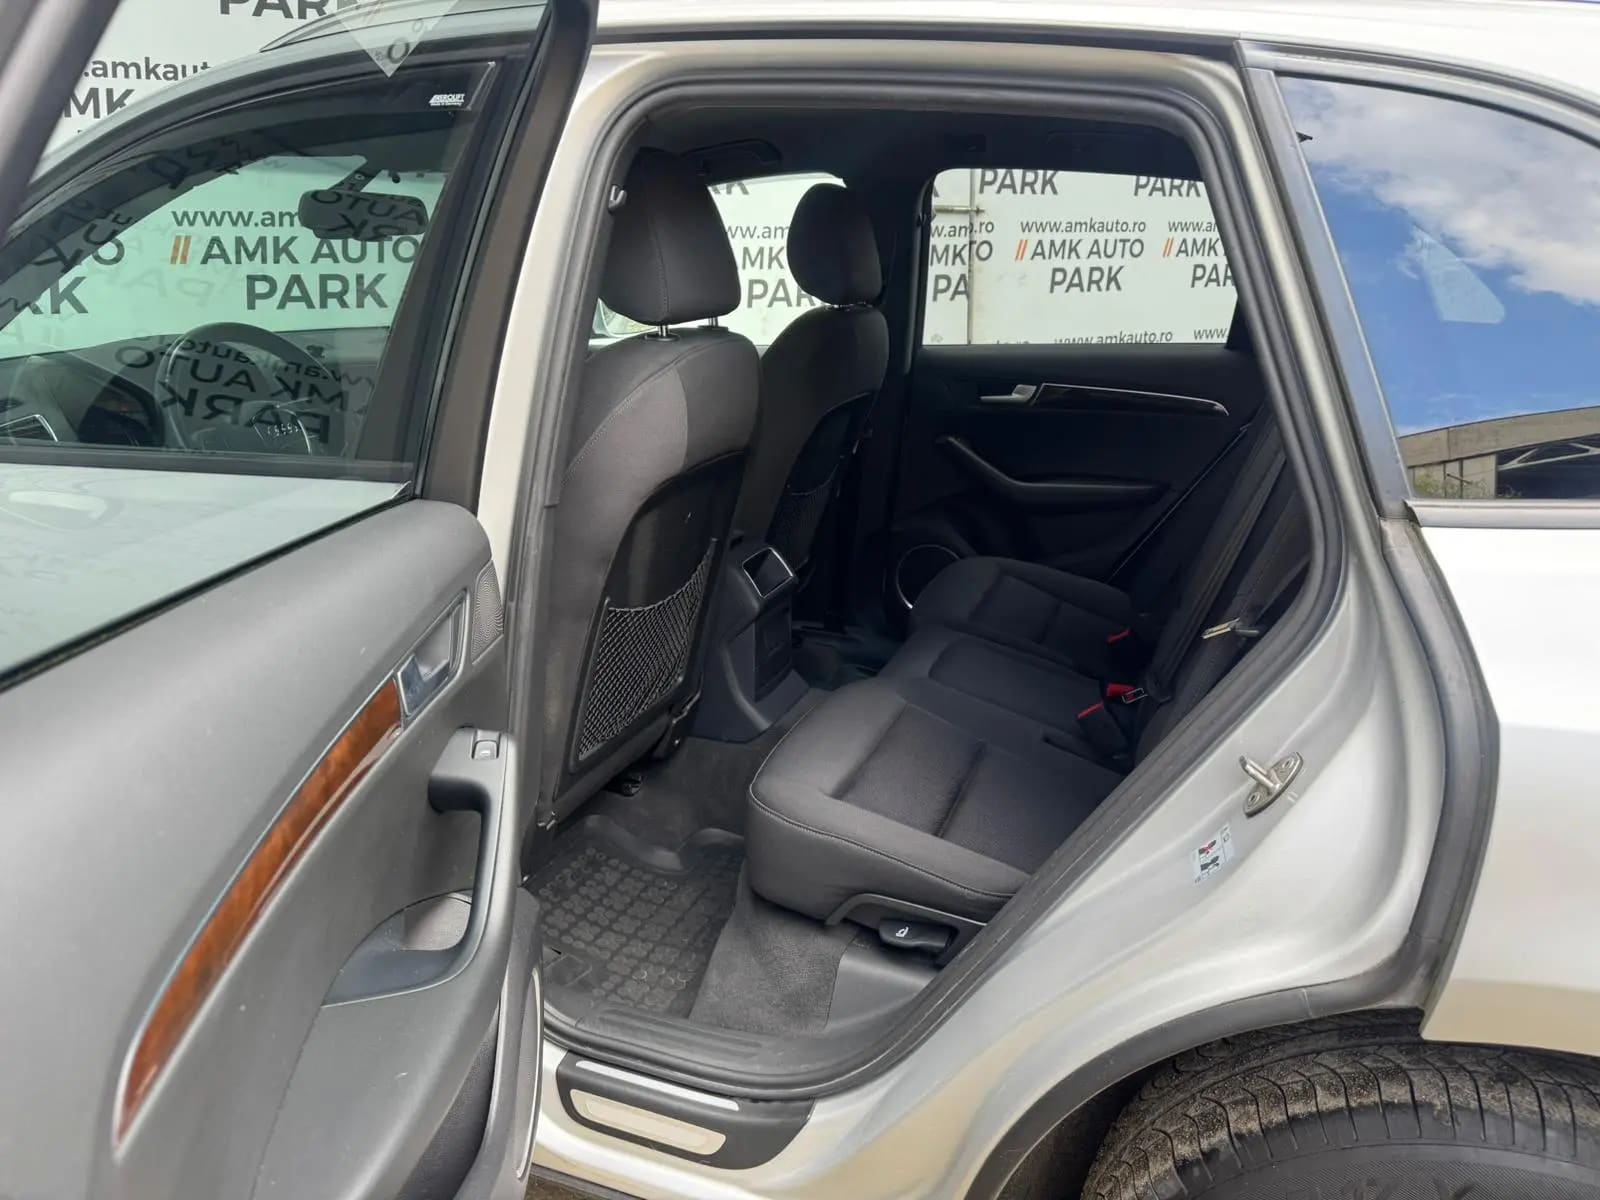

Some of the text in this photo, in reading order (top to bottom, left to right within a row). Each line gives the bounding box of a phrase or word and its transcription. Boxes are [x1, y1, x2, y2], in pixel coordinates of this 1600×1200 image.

[979, 169, 1058, 195] PARK
[1020, 217, 1146, 233] www.amkauto.ro
[200, 235, 419, 265] AMK AUTO
[1030, 238, 1145, 260] AMK AUTO
[1176, 237, 1219, 257] AMK
[246, 273, 388, 310] PARK
[1049, 265, 1124, 294] PARK
